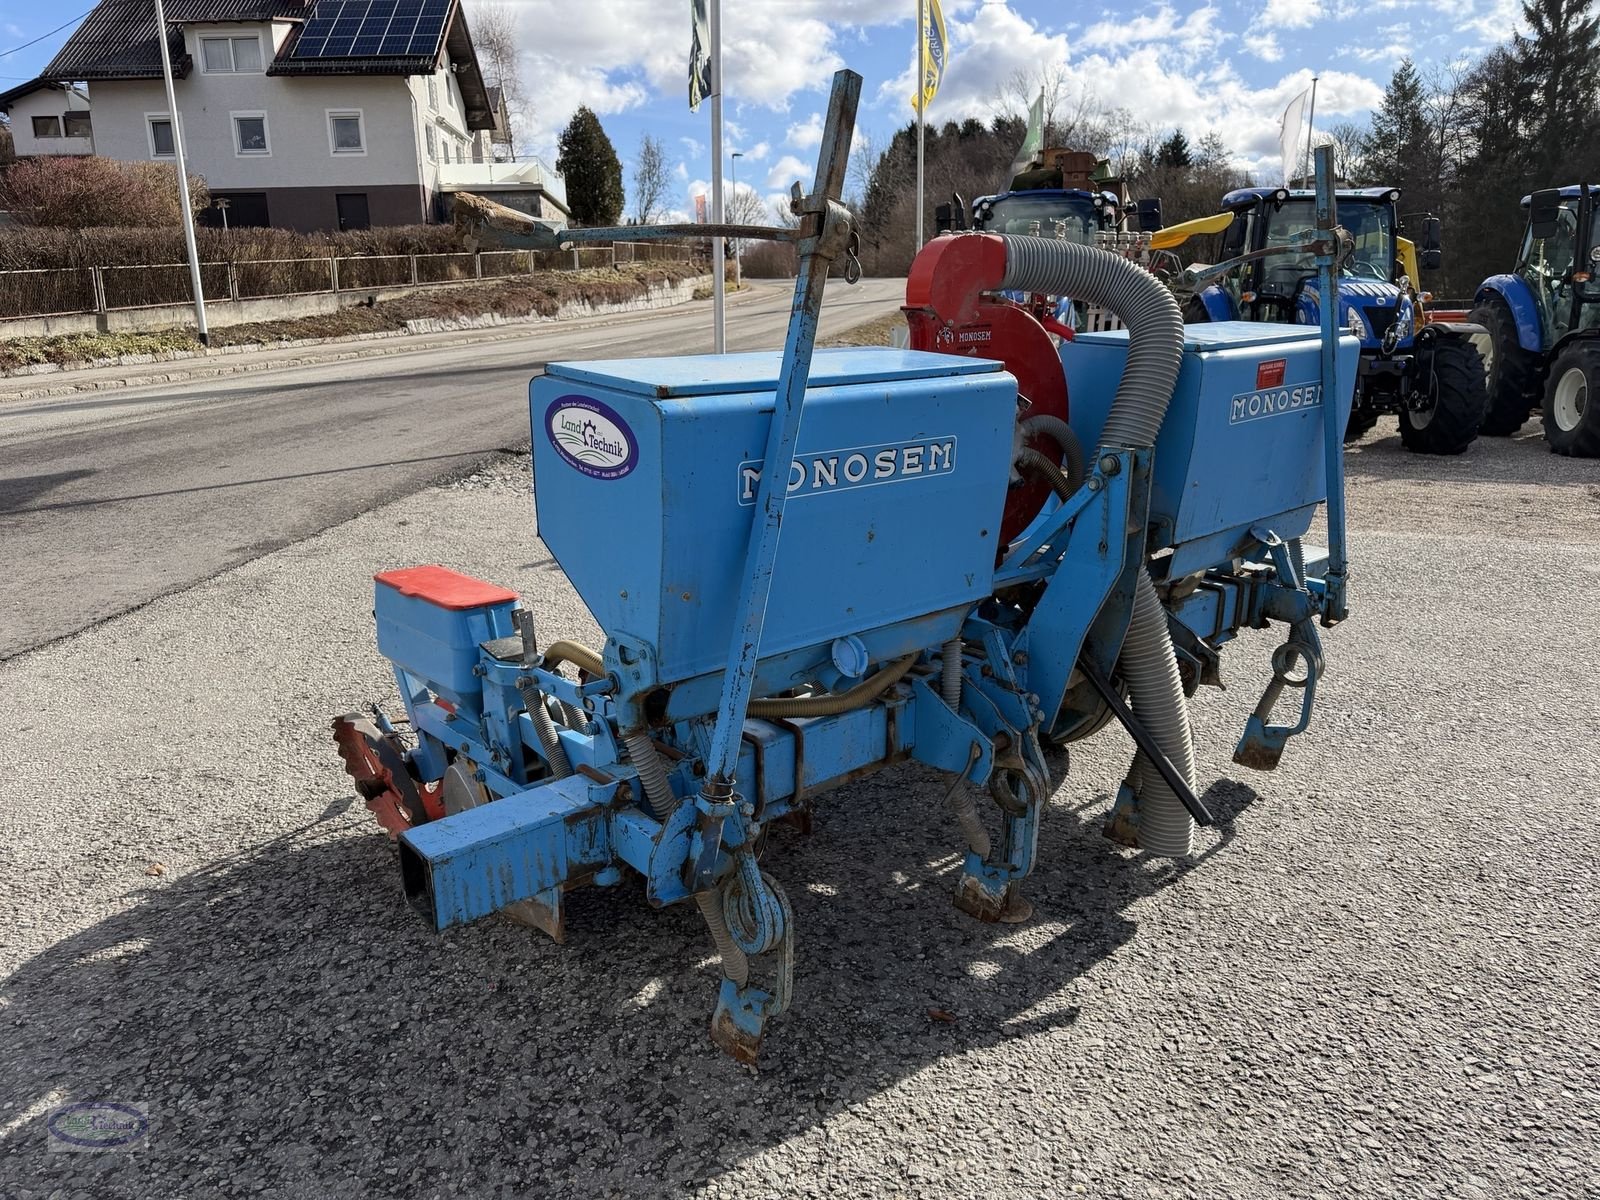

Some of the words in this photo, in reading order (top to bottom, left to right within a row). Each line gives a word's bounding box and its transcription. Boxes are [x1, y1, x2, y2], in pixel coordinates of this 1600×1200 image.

[959, 331, 992, 342] MONOSEM
[561, 415, 581, 434] Land
[589, 433, 623, 458] Technik
[742, 442, 953, 499] MONOSEM
